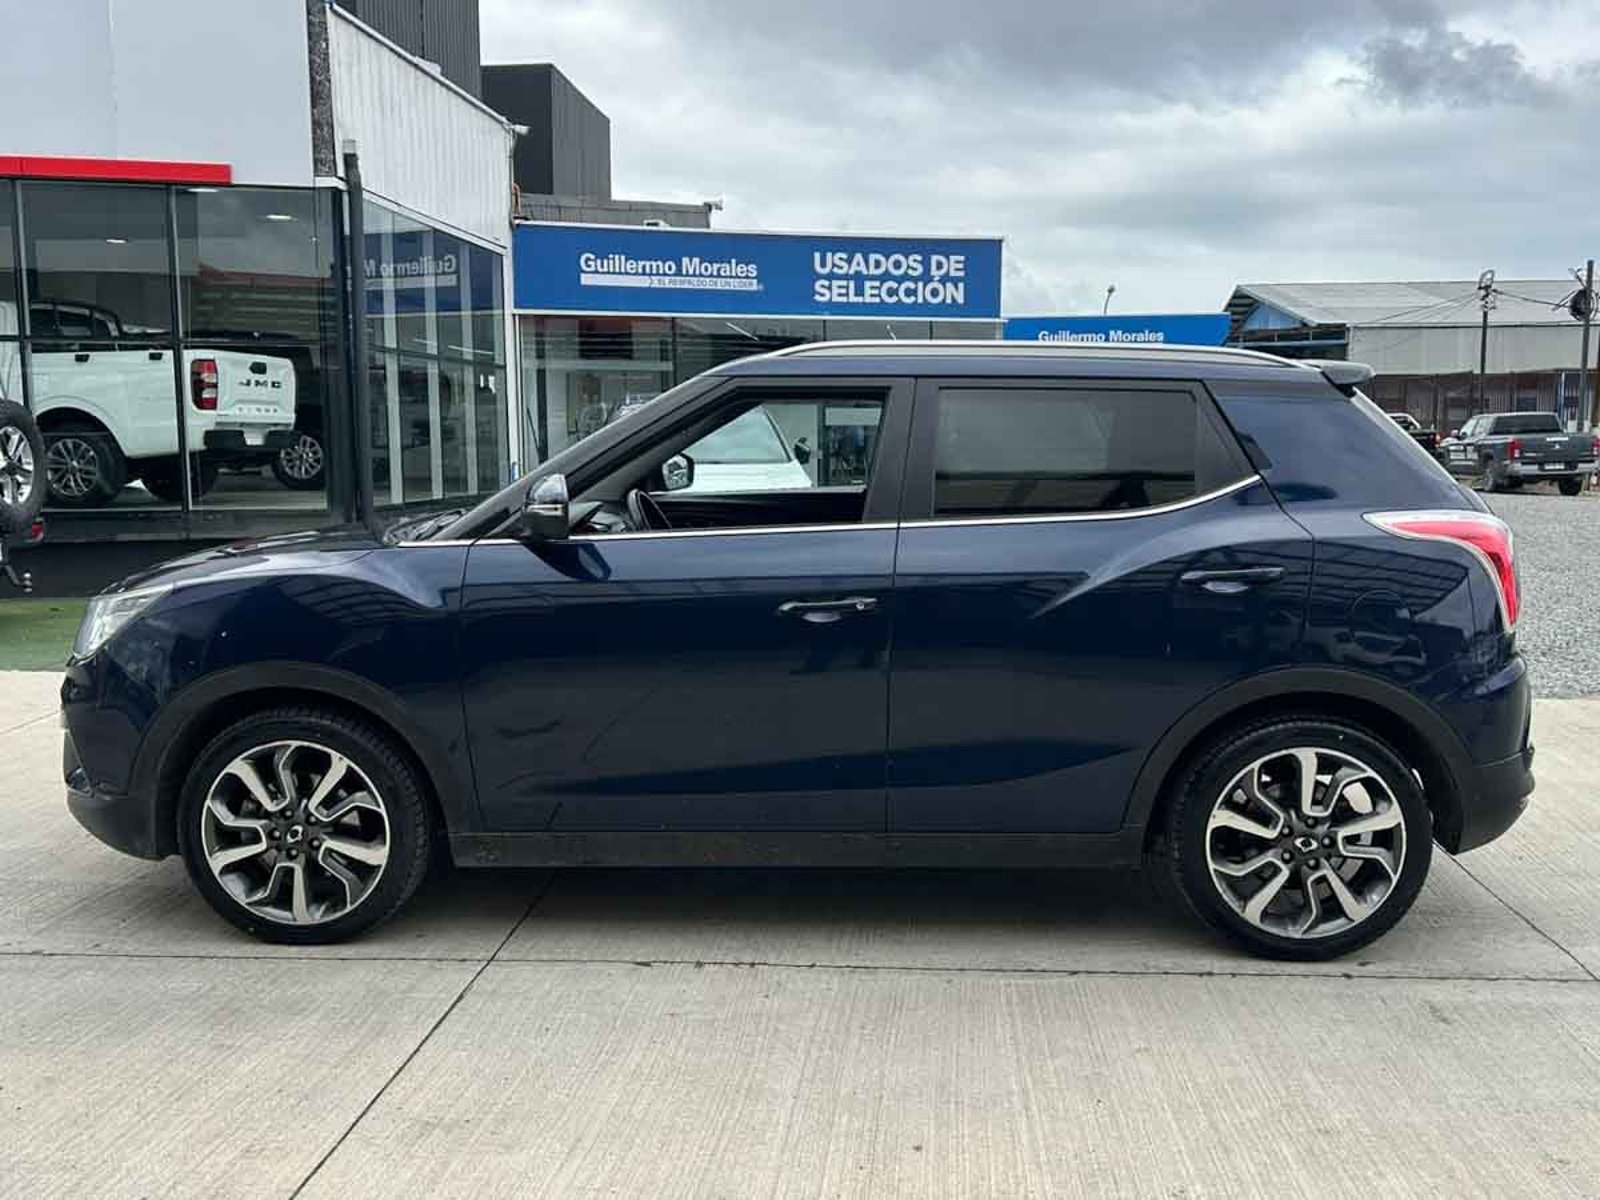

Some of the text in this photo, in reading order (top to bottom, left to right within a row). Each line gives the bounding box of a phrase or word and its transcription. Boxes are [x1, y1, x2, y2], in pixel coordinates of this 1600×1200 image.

[580, 253, 758, 277] Guillermo Morales
[813, 251, 966, 277] USADOS DE
[813, 277, 965, 304] SELECCIÓN
[1037, 330, 1164, 344] Guillermo Morales
[239, 379, 282, 389] JMC
